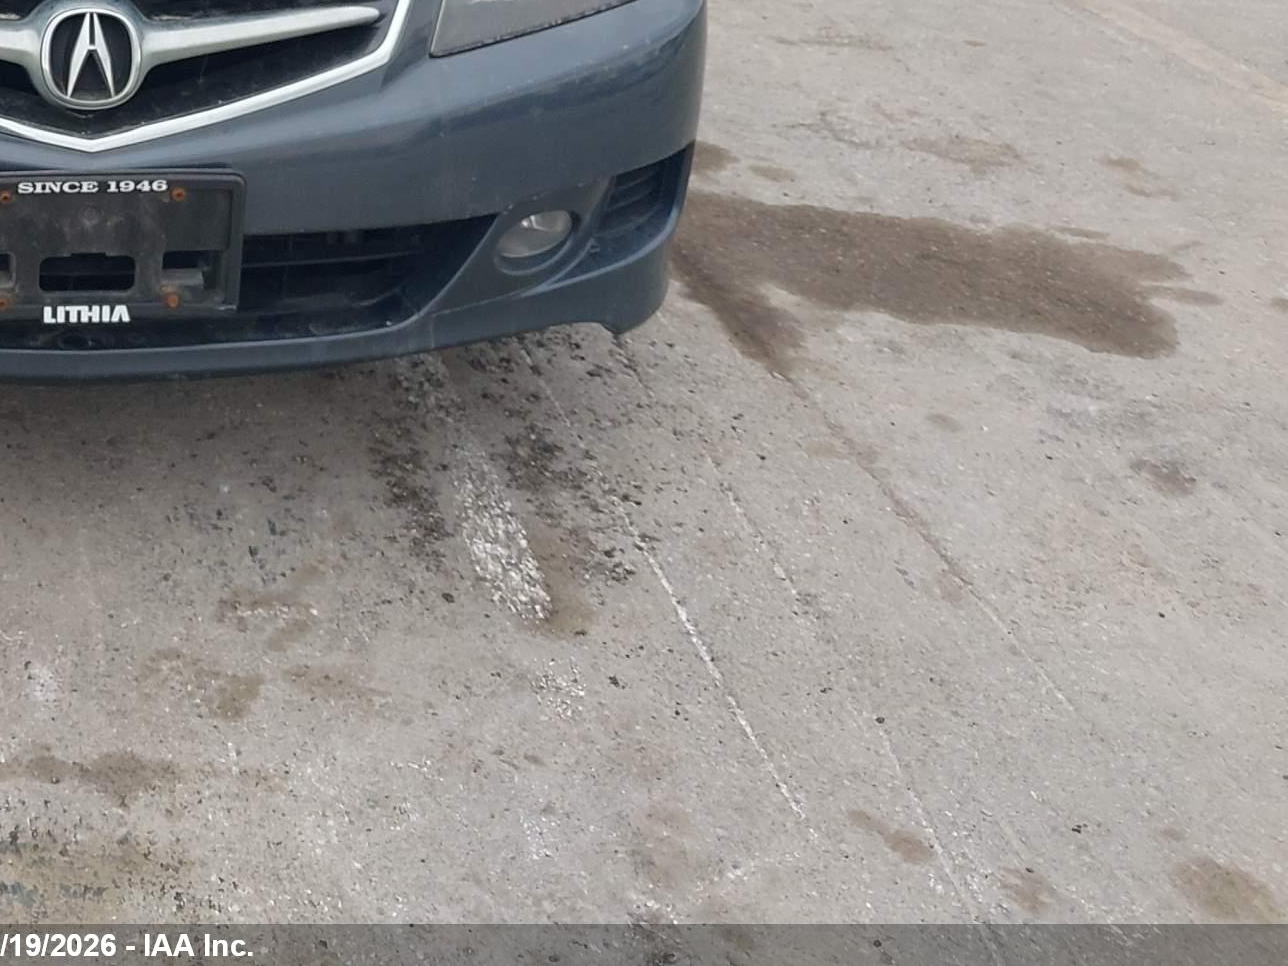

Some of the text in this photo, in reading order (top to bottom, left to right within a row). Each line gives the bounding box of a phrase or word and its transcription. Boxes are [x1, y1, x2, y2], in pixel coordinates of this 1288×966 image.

[17, 179, 168, 194] SINCE 1946
[43, 304, 130, 324] LITHIA
